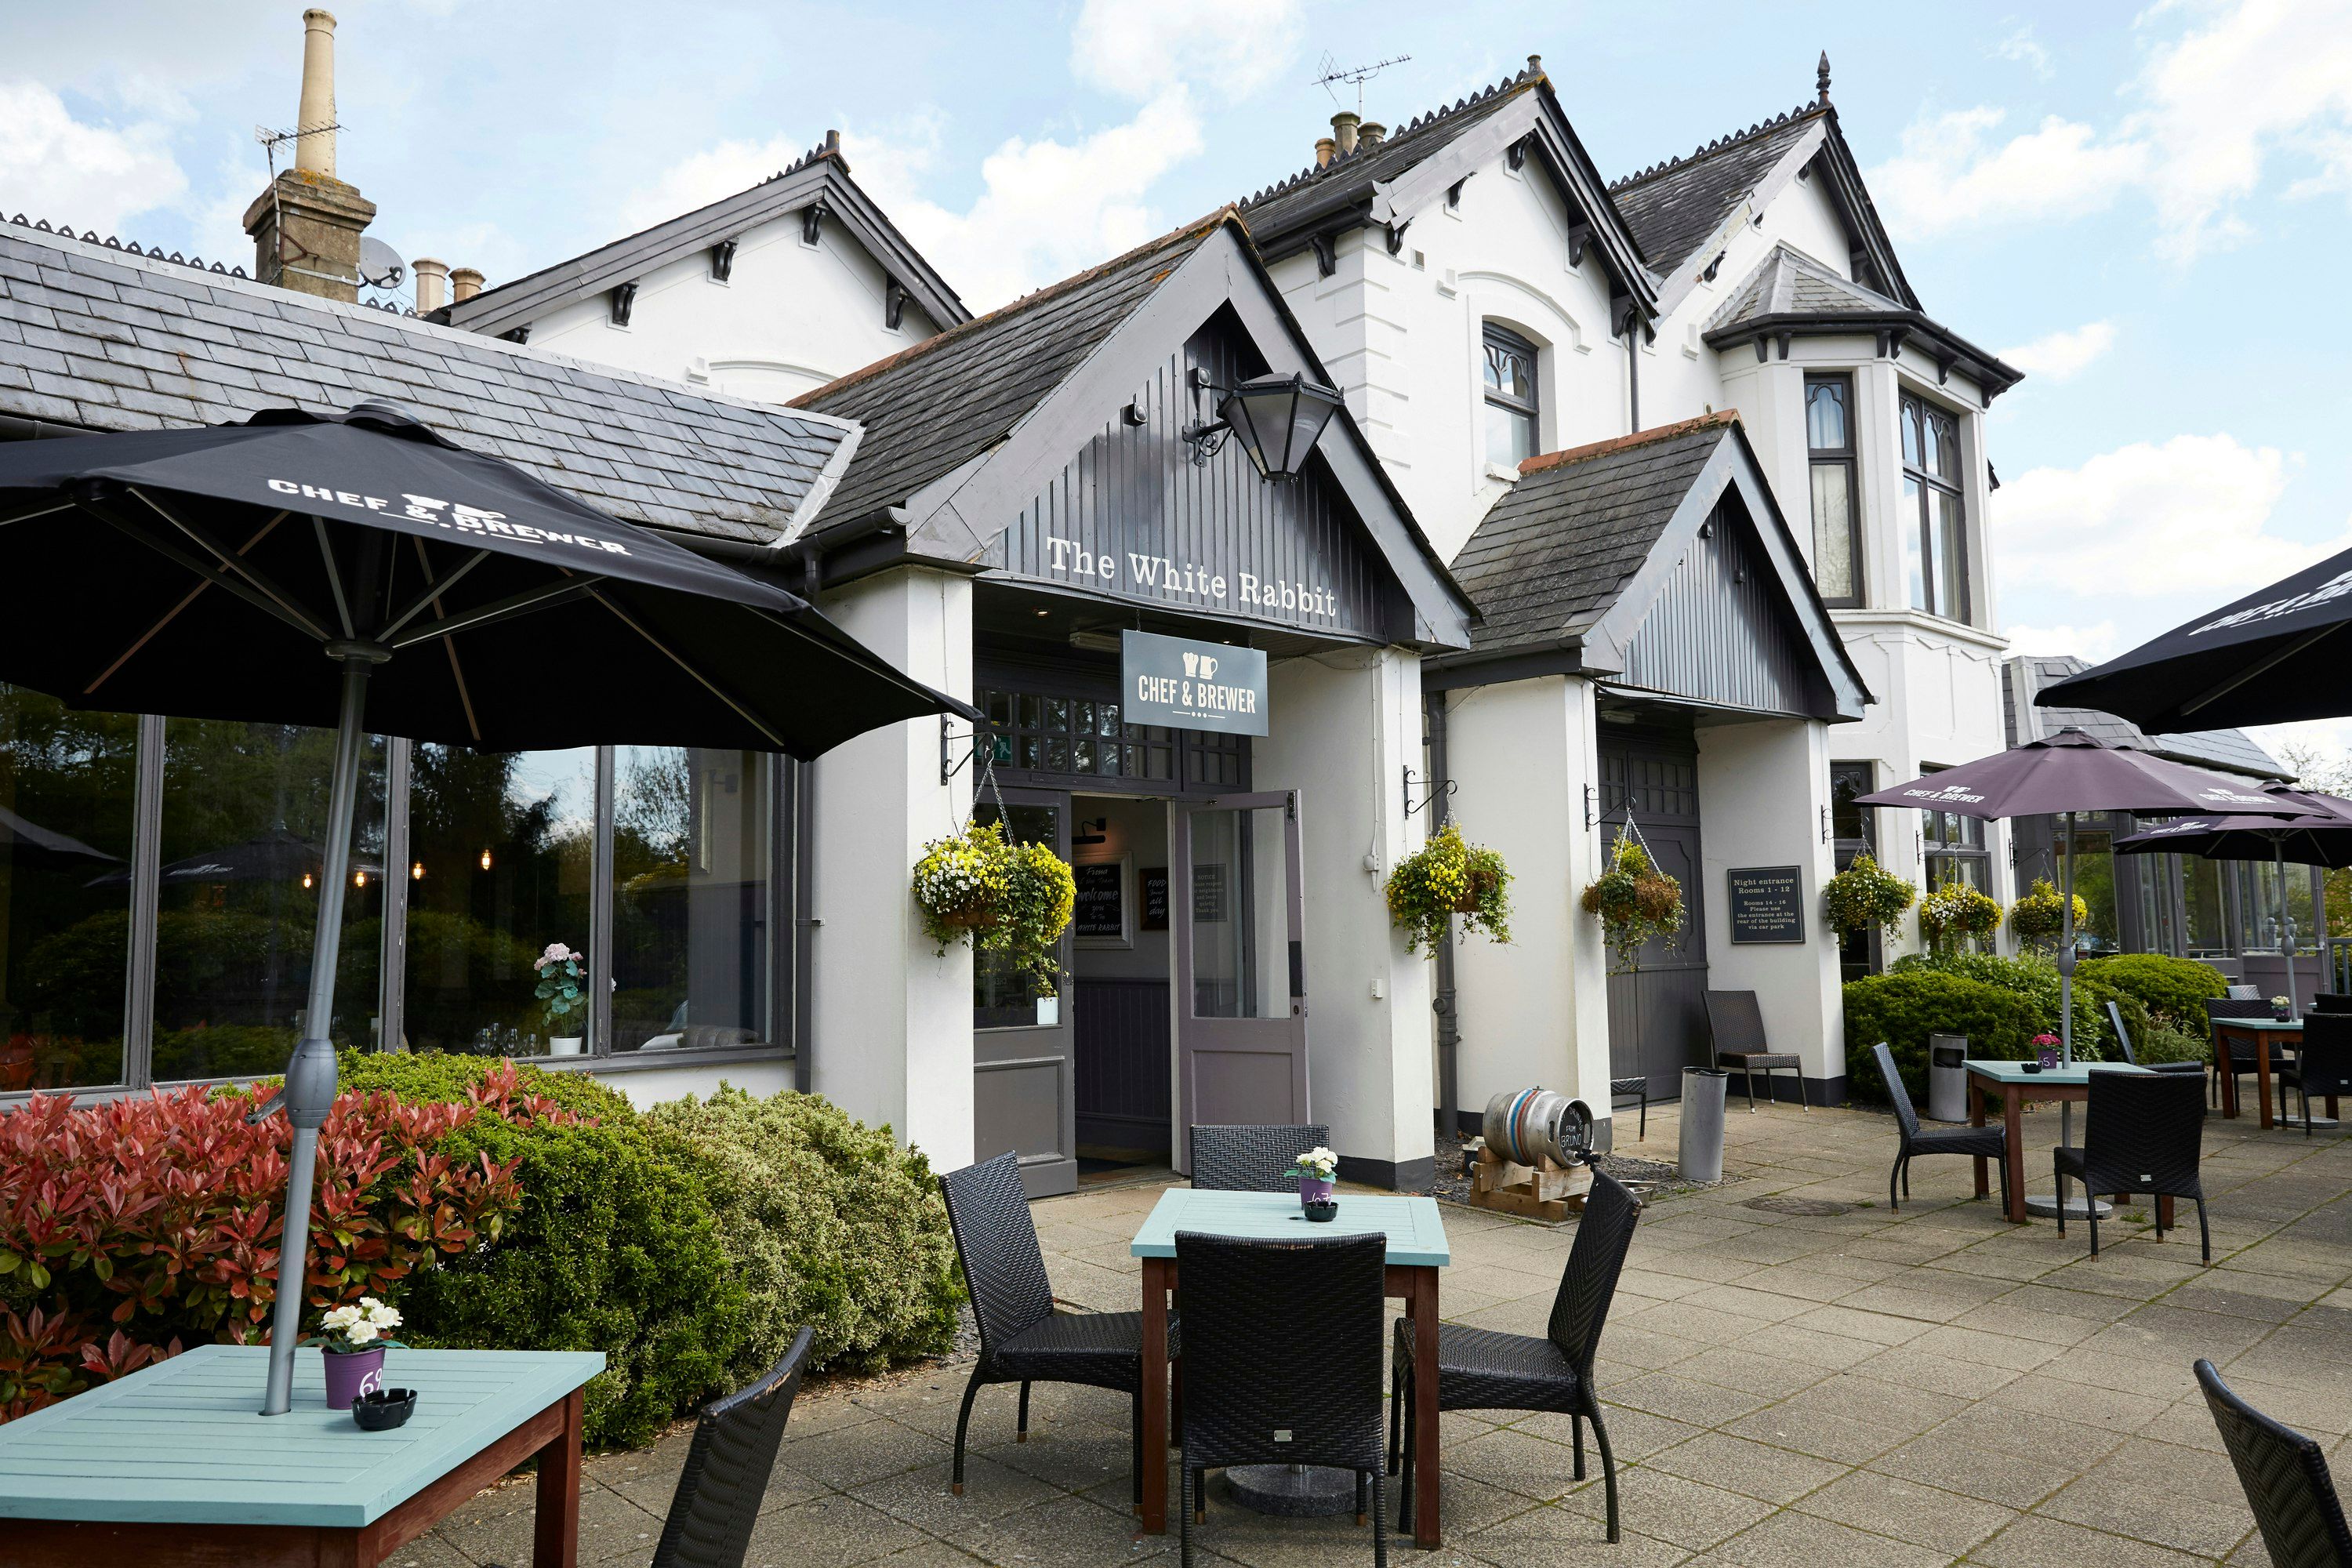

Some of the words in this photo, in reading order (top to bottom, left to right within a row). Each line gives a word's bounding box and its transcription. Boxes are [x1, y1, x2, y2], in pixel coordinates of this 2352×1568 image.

[268, 478, 389, 510] CHEF
[405, 504, 439, 521] &
[452, 512, 633, 556] BREWER
[1047, 536, 1115, 579] The
[1128, 552, 1227, 599] White
[1239, 572, 1336, 617] Rabbit
[1138, 675, 1178, 704] CHEF
[1181, 681, 1192, 707] &
[1197, 682, 1256, 714] BREWER
[1903, 789, 1935, 797] CHEF
[1939, 793, 1985, 804] BREWER
[1148, 879, 1167, 887] FOOD
[1077, 887, 1119, 902] welcome
[1089, 905, 1105, 916] you
[1149, 906, 1166, 919] day
[1098, 923, 1120, 931] RABBIT
[1566, 1124, 1577, 1133] FROM
[1561, 1134, 1582, 1148] BRUNO
[359, 1368, 383, 1398] 69
